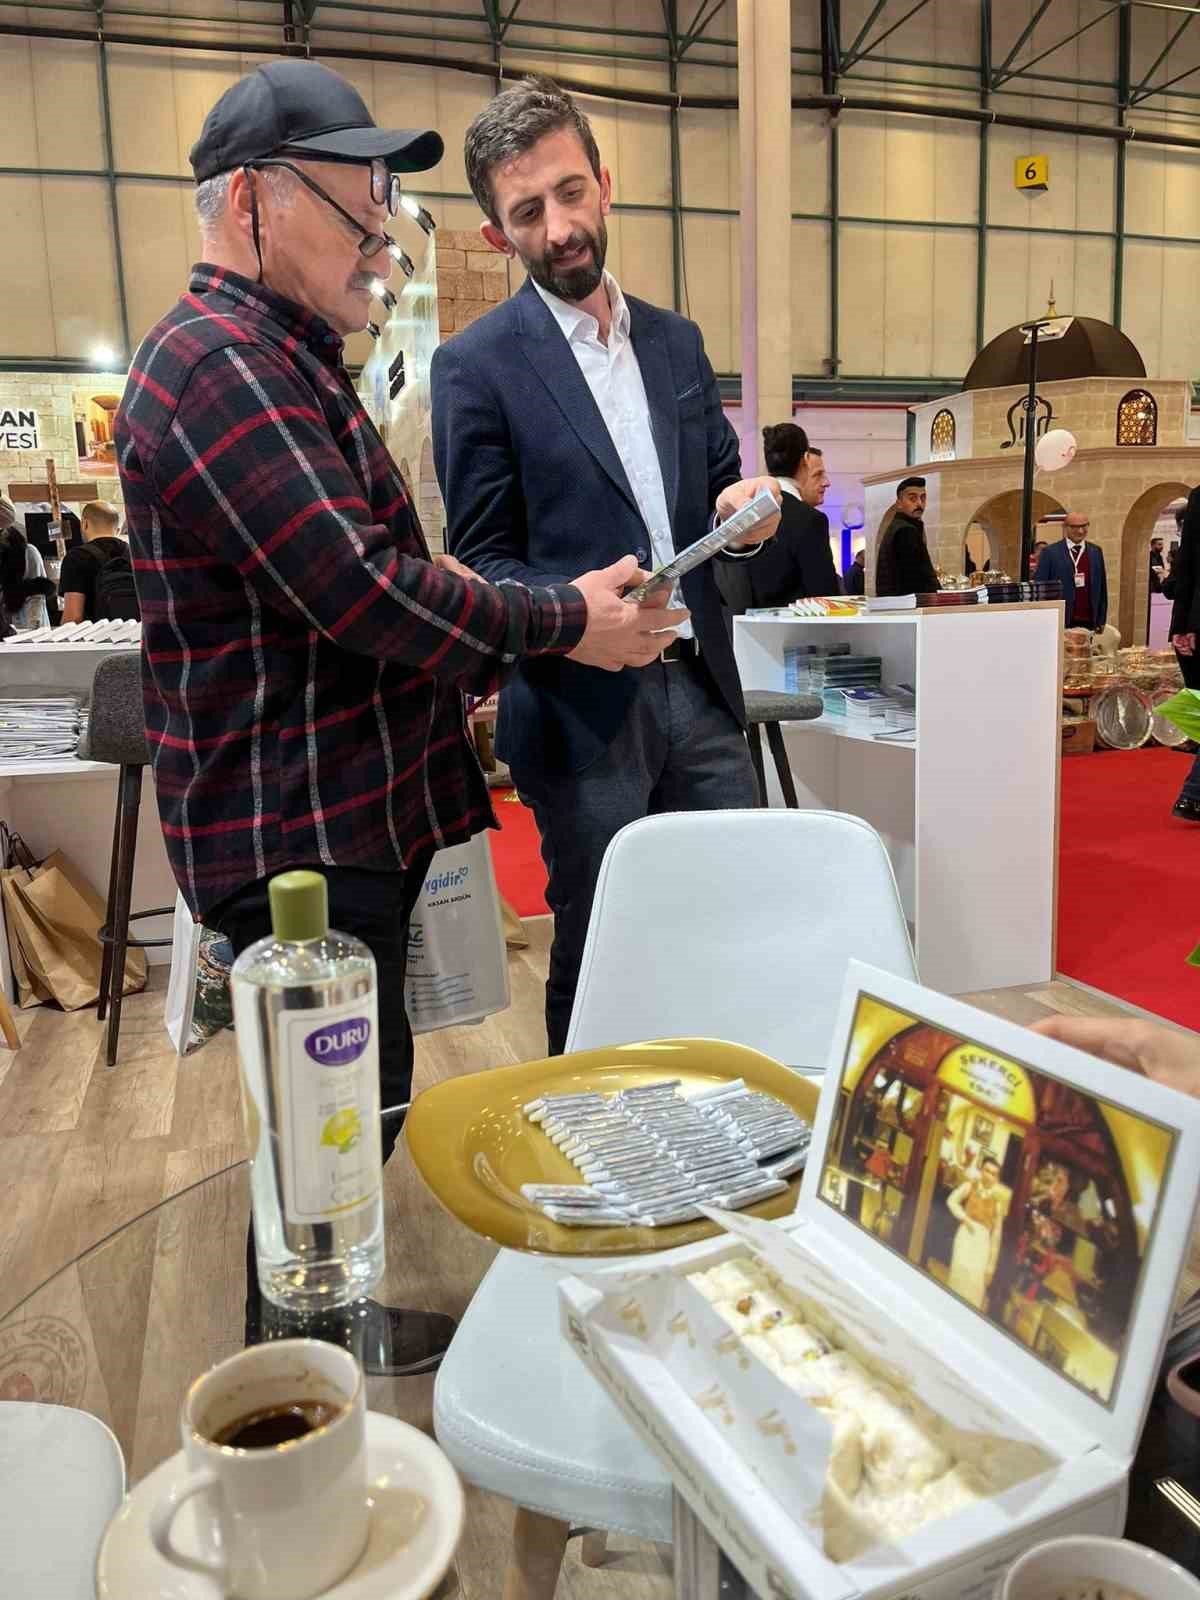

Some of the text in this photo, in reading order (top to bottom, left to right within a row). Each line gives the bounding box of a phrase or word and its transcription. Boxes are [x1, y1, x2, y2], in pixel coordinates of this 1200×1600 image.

[1025, 161, 1037, 181] 6
[0, 410, 35, 428] AN
[315, 1022, 369, 1056] DURU
